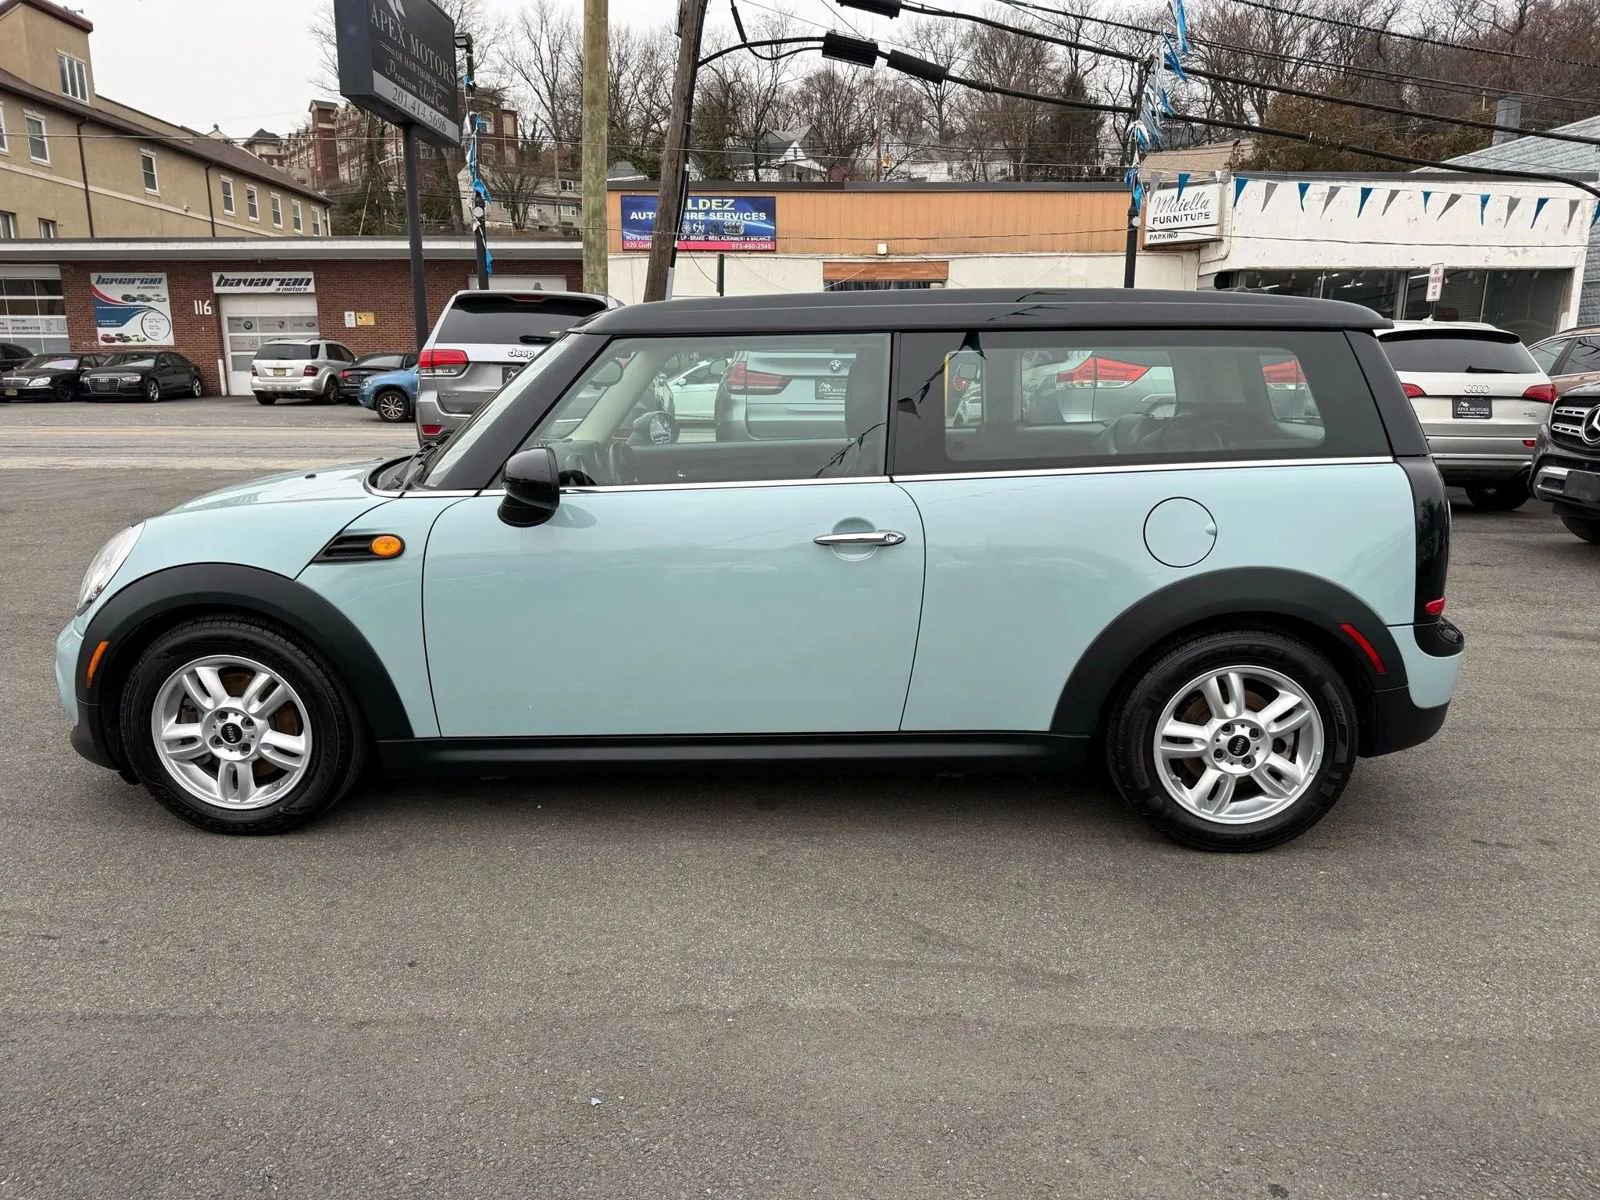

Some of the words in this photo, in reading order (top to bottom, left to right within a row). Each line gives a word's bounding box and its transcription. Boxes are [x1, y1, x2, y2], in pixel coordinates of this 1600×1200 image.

[371, 3, 407, 49] APEX
[410, 33, 456, 87] MOTORS
[385, 59, 417, 93] Premium
[391, 87, 447, 133] 201.414.5696
[684, 199, 735, 211] LDEZ
[709, 212, 767, 221] SERVICES
[1152, 211, 1211, 225] FURNITURE
[1149, 232, 1178, 240] PARKING
[96, 274, 163, 284] bavarian
[215, 273, 312, 287] bavarian
[194, 299, 212, 315] 116
[508, 348, 535, 358] Jeep
